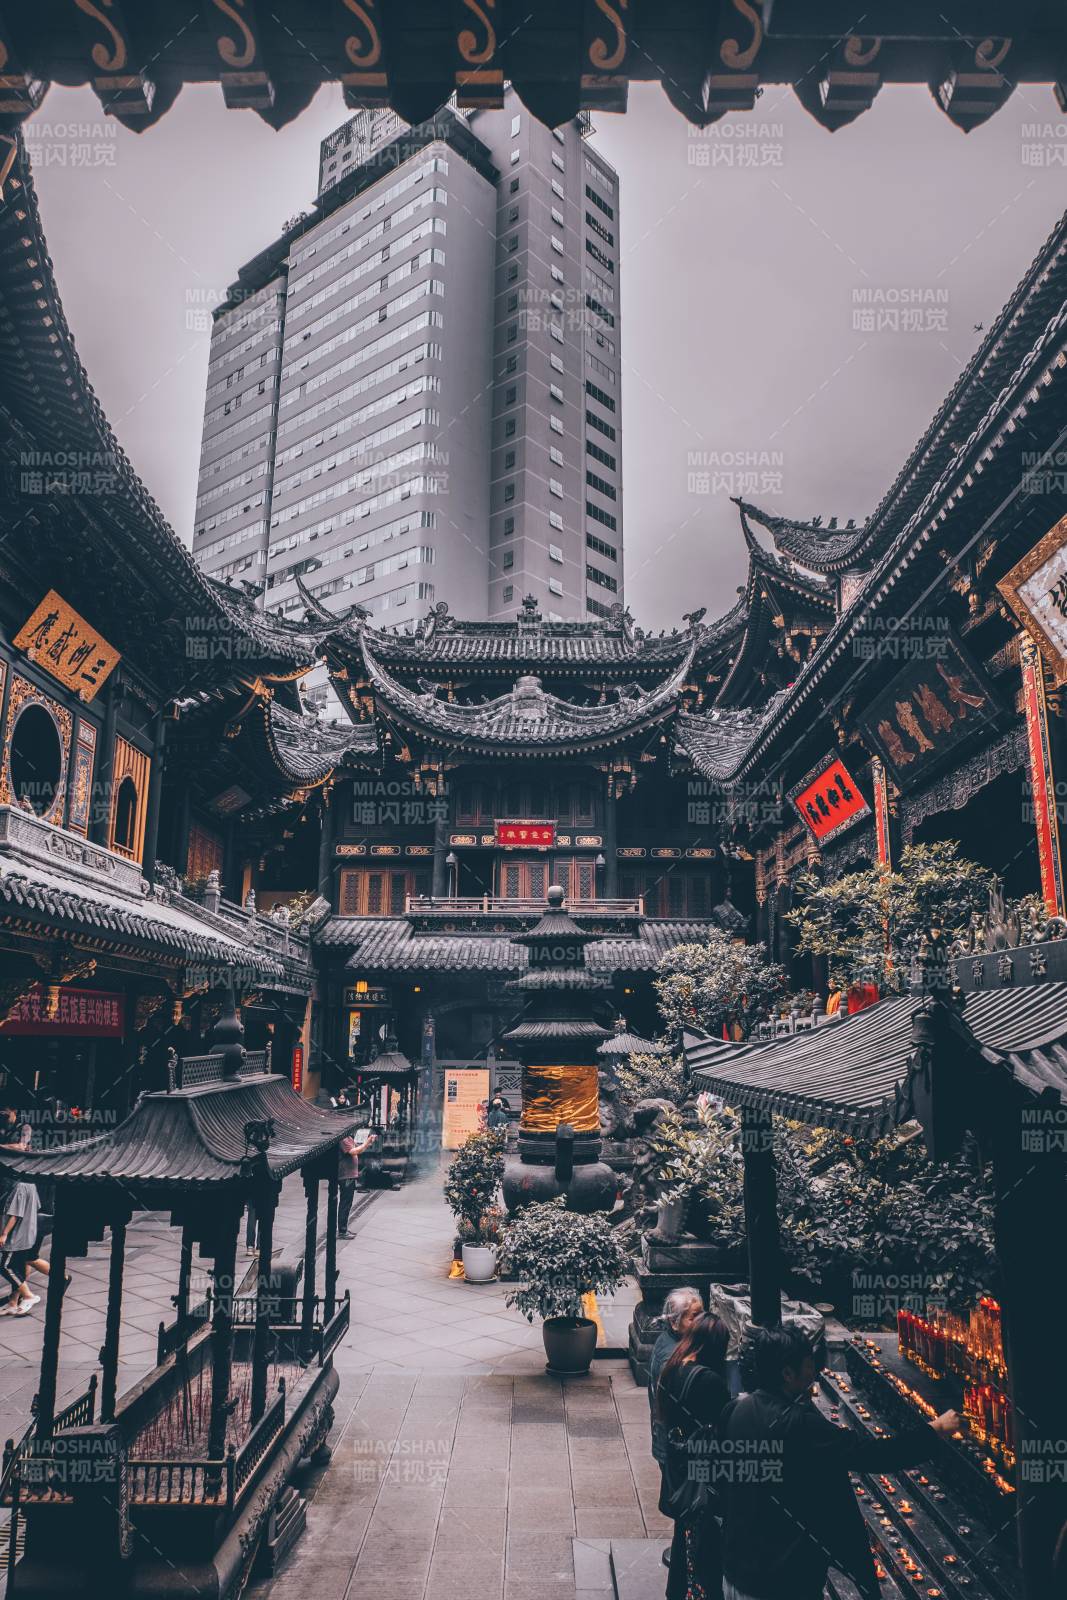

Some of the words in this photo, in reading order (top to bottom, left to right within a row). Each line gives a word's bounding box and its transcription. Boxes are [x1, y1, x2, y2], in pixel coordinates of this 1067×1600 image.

[8, 991, 119, 1026] 国家安民族复兴的根基
